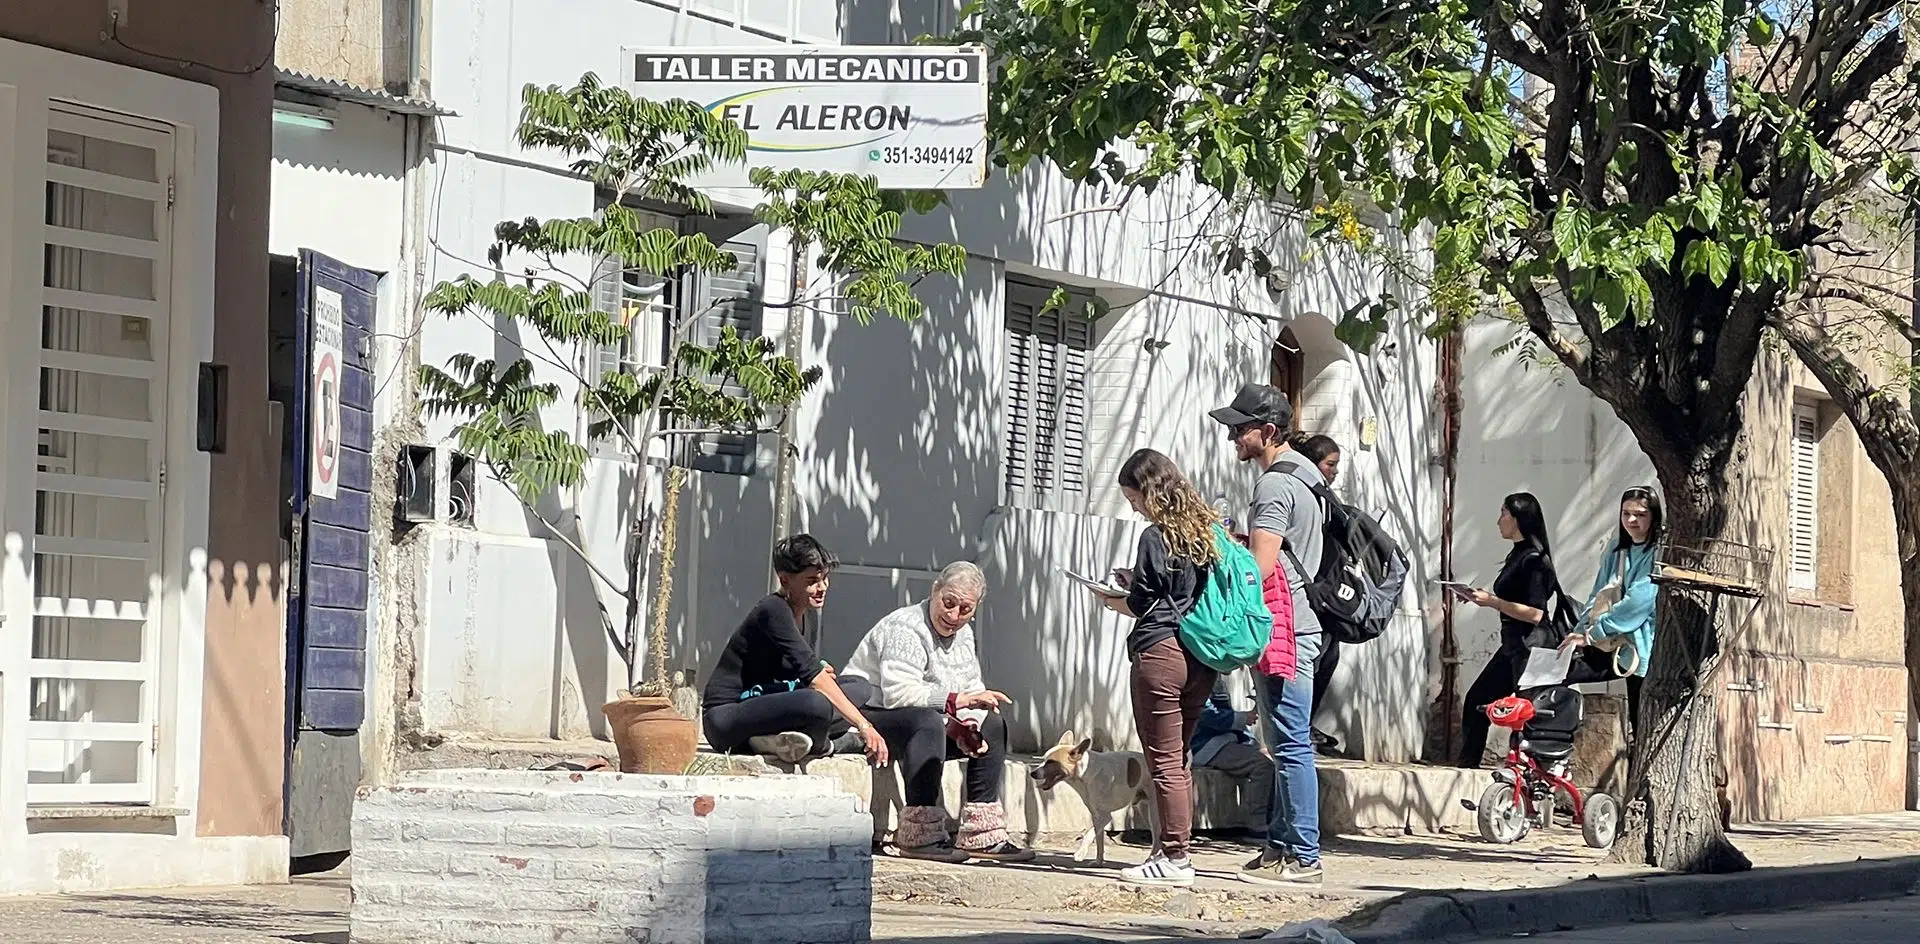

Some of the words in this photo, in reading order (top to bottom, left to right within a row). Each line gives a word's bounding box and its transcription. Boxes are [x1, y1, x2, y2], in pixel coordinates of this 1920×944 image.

[646, 56, 776, 81] TALLER
[786, 57, 969, 81] MECANICO
[721, 104, 760, 130] EL
[775, 104, 911, 131] ALERON
[883, 146, 974, 164] 351-3494142
